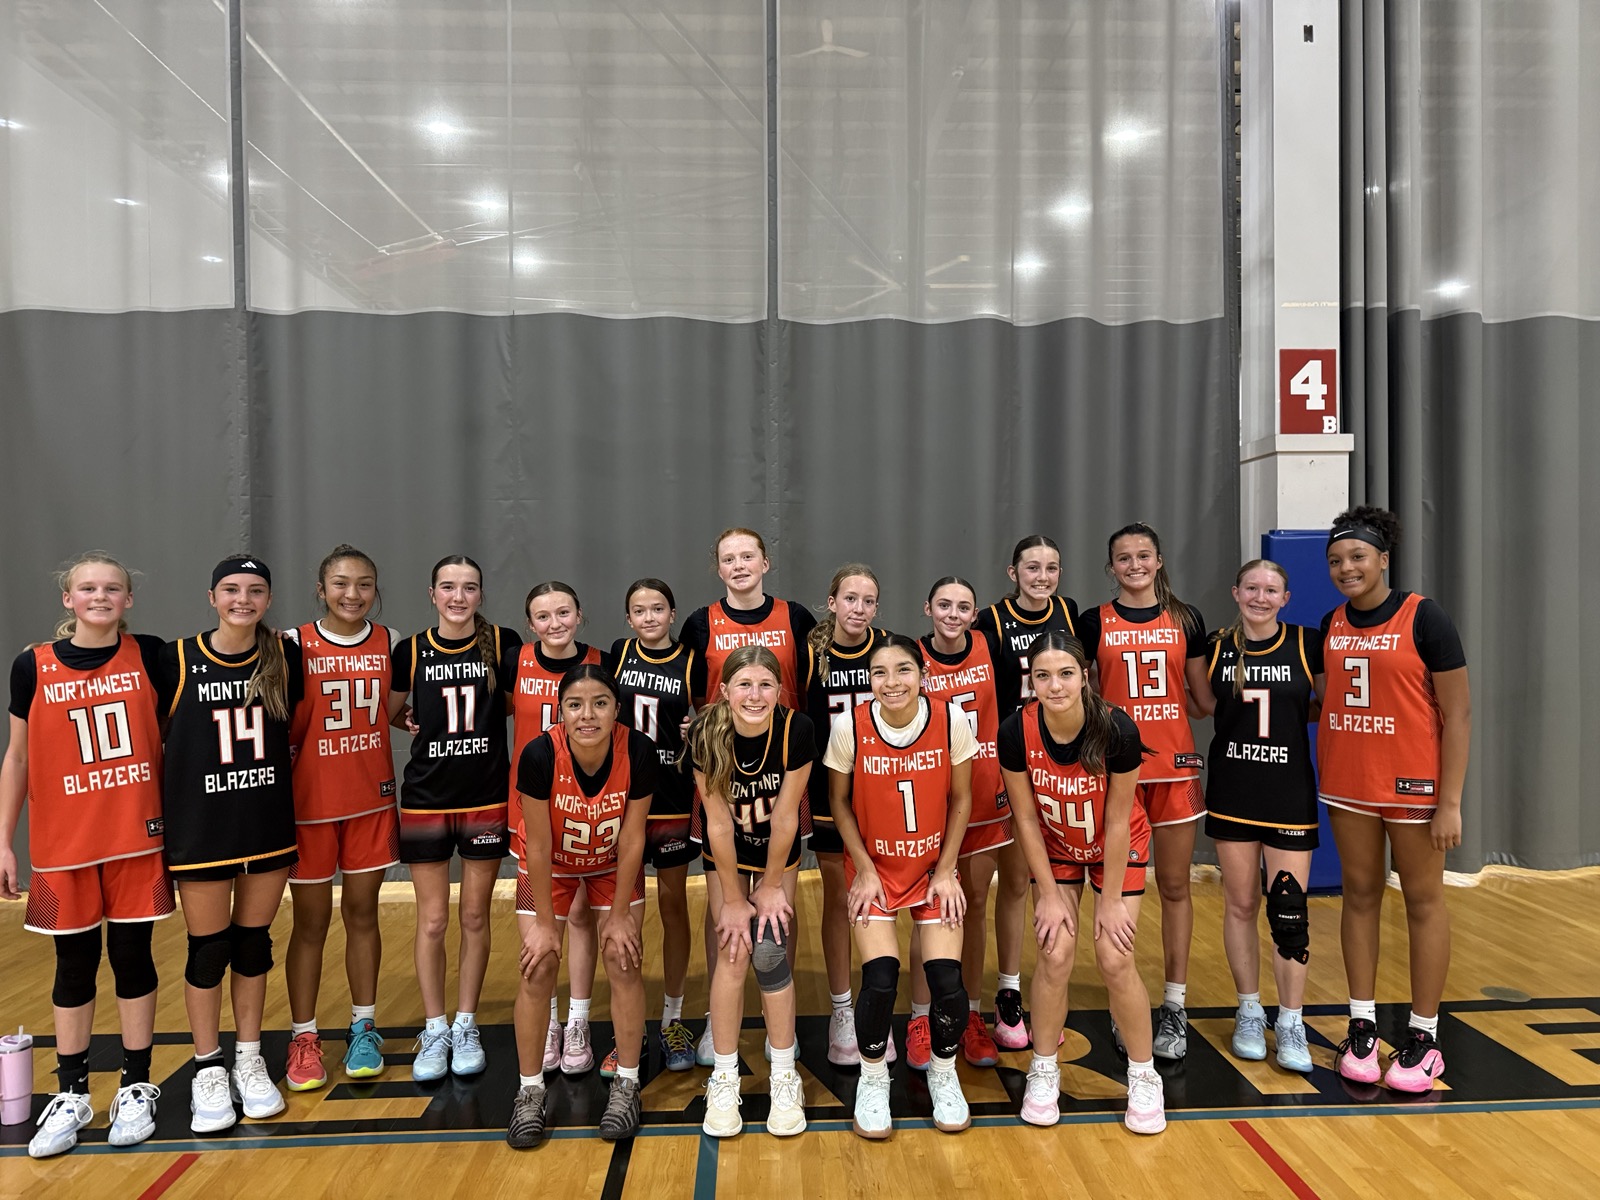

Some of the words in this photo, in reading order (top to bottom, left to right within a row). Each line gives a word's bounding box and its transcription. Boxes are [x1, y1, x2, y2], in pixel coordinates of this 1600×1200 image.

[1290, 360, 1328, 410] 4
[1322, 416, 1337, 433] B
[715, 630, 787, 651] NORTHWEST
[1105, 629, 1180, 647] NORTHWEST
[1330, 633, 1401, 651] NORTHWEST
[307, 655, 387, 675] NORTHWEST
[925, 664, 991, 693] NORTHWEST
[1121, 650, 1168, 699] 13
[44, 672, 141, 704] NORTHWEST
[620, 669, 681, 696] MONTANA
[1344, 657, 1370, 708] 3
[321, 678, 380, 731] 34
[441, 685, 475, 734] 11
[634, 693, 660, 743] 0
[1241, 689, 1270, 738] 7
[68, 701, 133, 765] 10
[212, 705, 265, 765] 14
[1330, 713, 1395, 735] BLAZERS
[318, 732, 382, 756] BLAZERS
[429, 738, 489, 757] BLAZERS
[1226, 741, 1288, 763] BLAZERS
[863, 749, 943, 775] NORTHWEST
[63, 762, 150, 795] BLAZERS
[205, 767, 275, 793] BLAZERS
[1028, 765, 1104, 796] ORTHWEST
[896, 780, 918, 833] 1
[1037, 793, 1096, 844] 24
[562, 815, 622, 855] 23
[875, 832, 941, 858] BLAZERS
